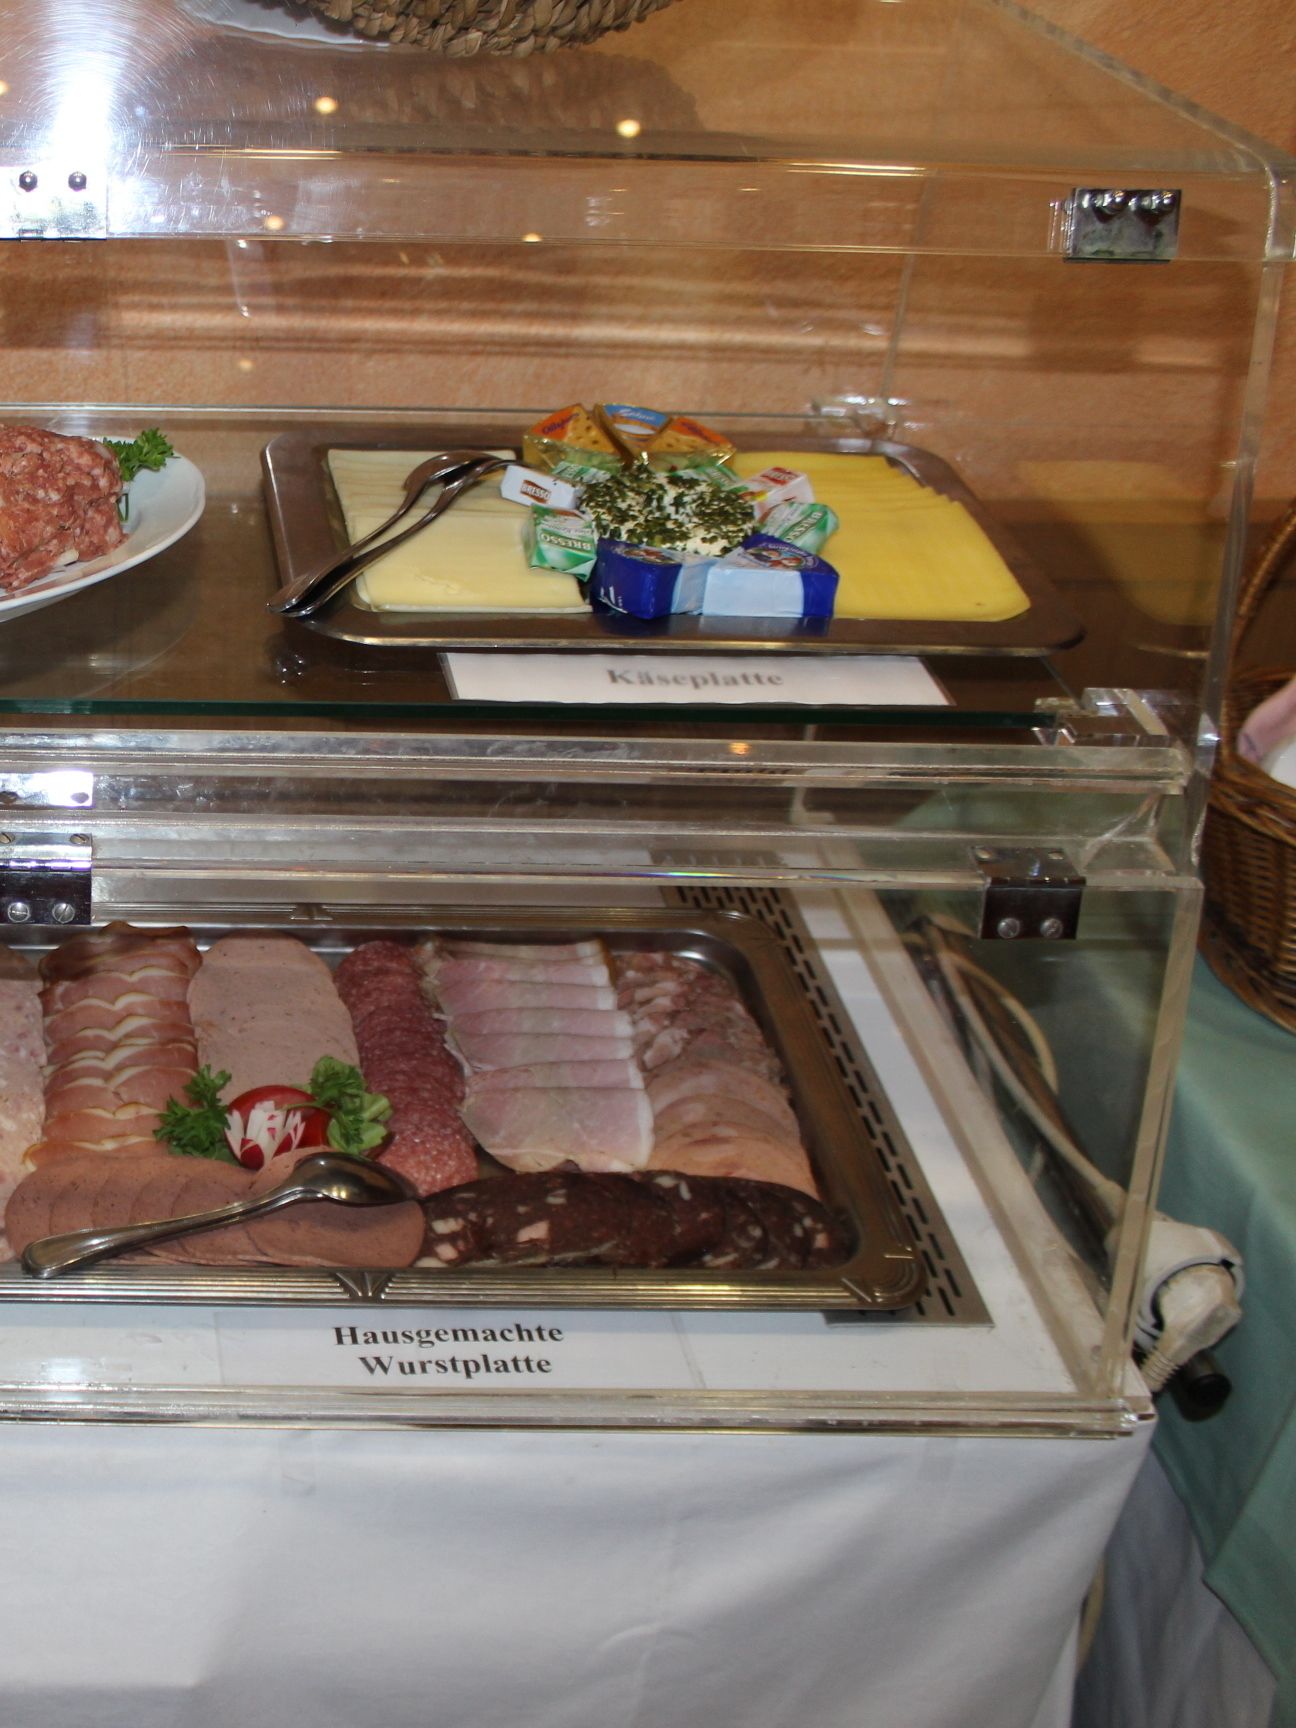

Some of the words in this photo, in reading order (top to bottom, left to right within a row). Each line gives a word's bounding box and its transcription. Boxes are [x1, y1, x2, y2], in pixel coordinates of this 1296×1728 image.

[520, 483, 551, 501] BRESSO
[540, 532, 592, 551] BRESSO
[607, 668, 785, 691] Käseplatte
[333, 1323, 564, 1349] Hausgemachte
[358, 1353, 553, 1380] Wurstplatte
